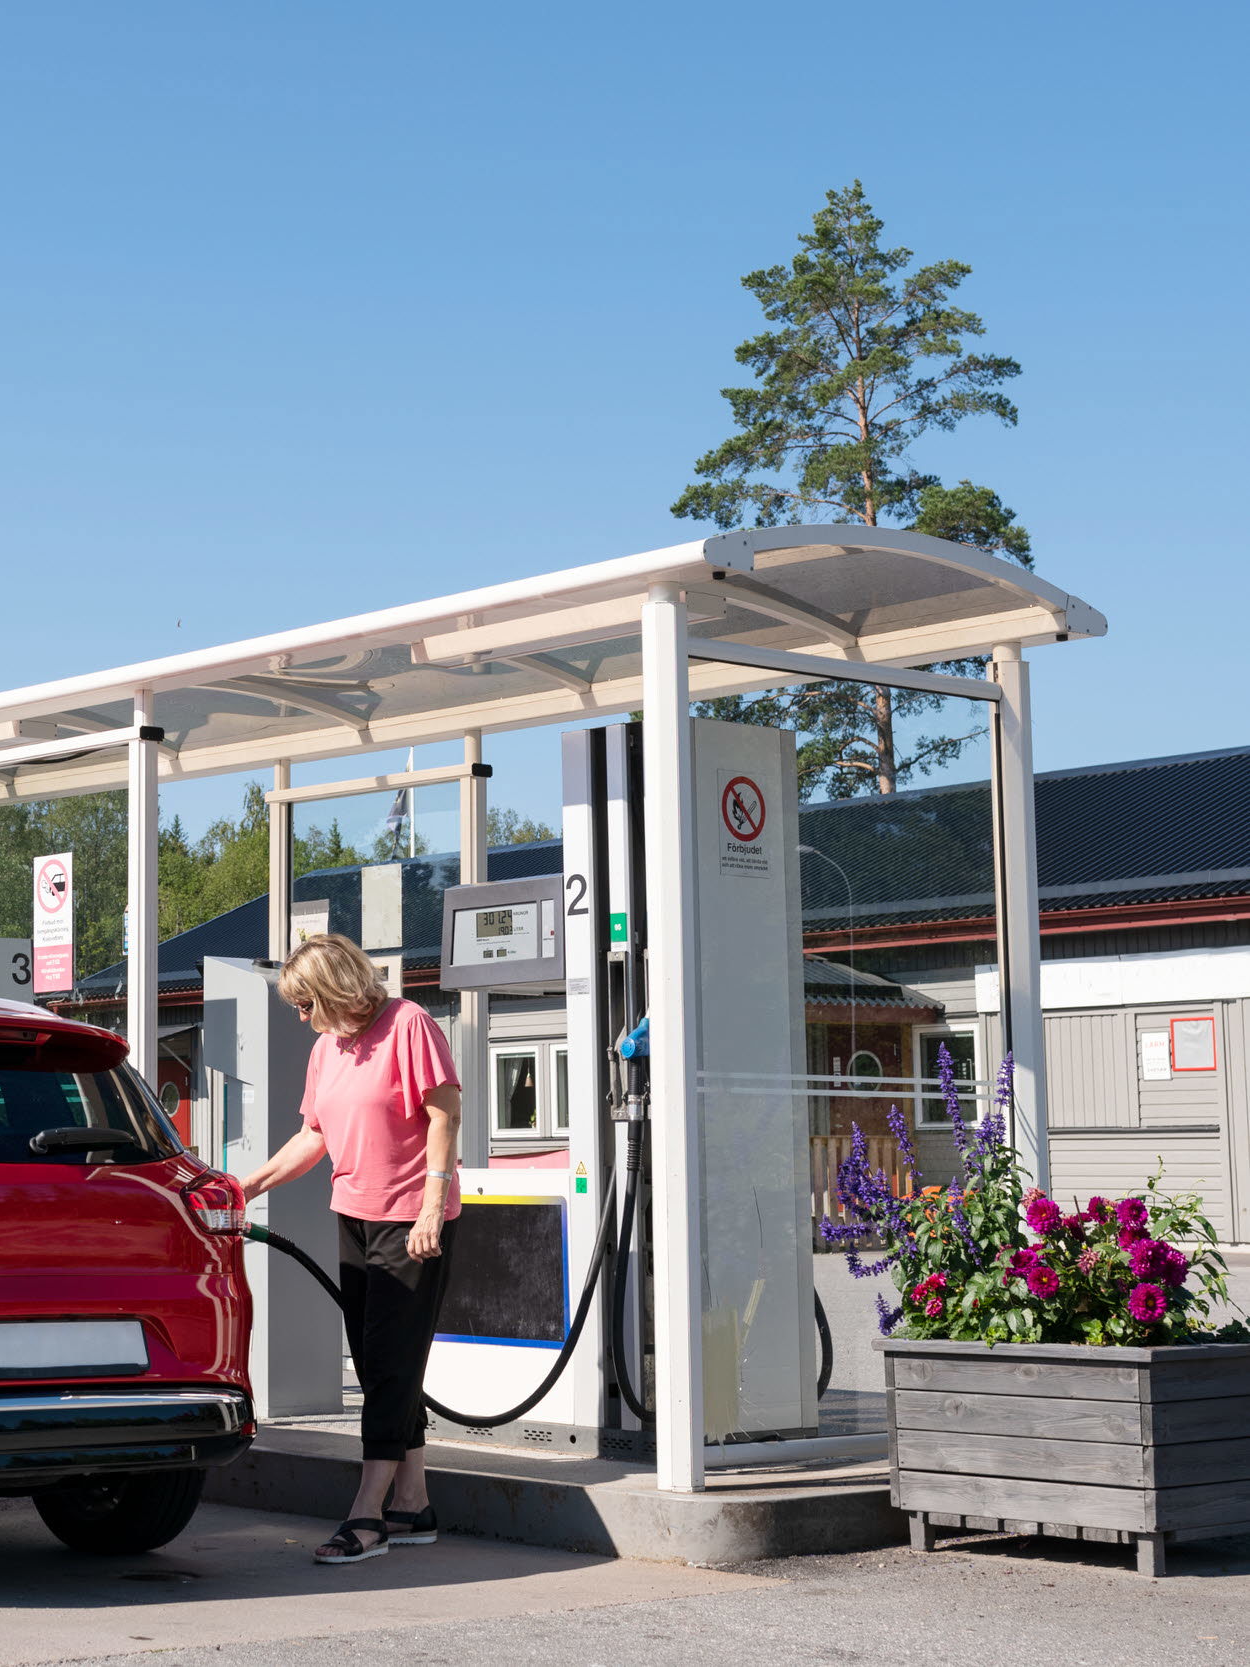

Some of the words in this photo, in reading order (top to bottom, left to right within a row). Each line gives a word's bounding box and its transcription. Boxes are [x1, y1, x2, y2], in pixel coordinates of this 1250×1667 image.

[727, 842, 762, 855] Förbjudet
[566, 874, 589, 916] 2
[12, 952, 31, 985] 3
